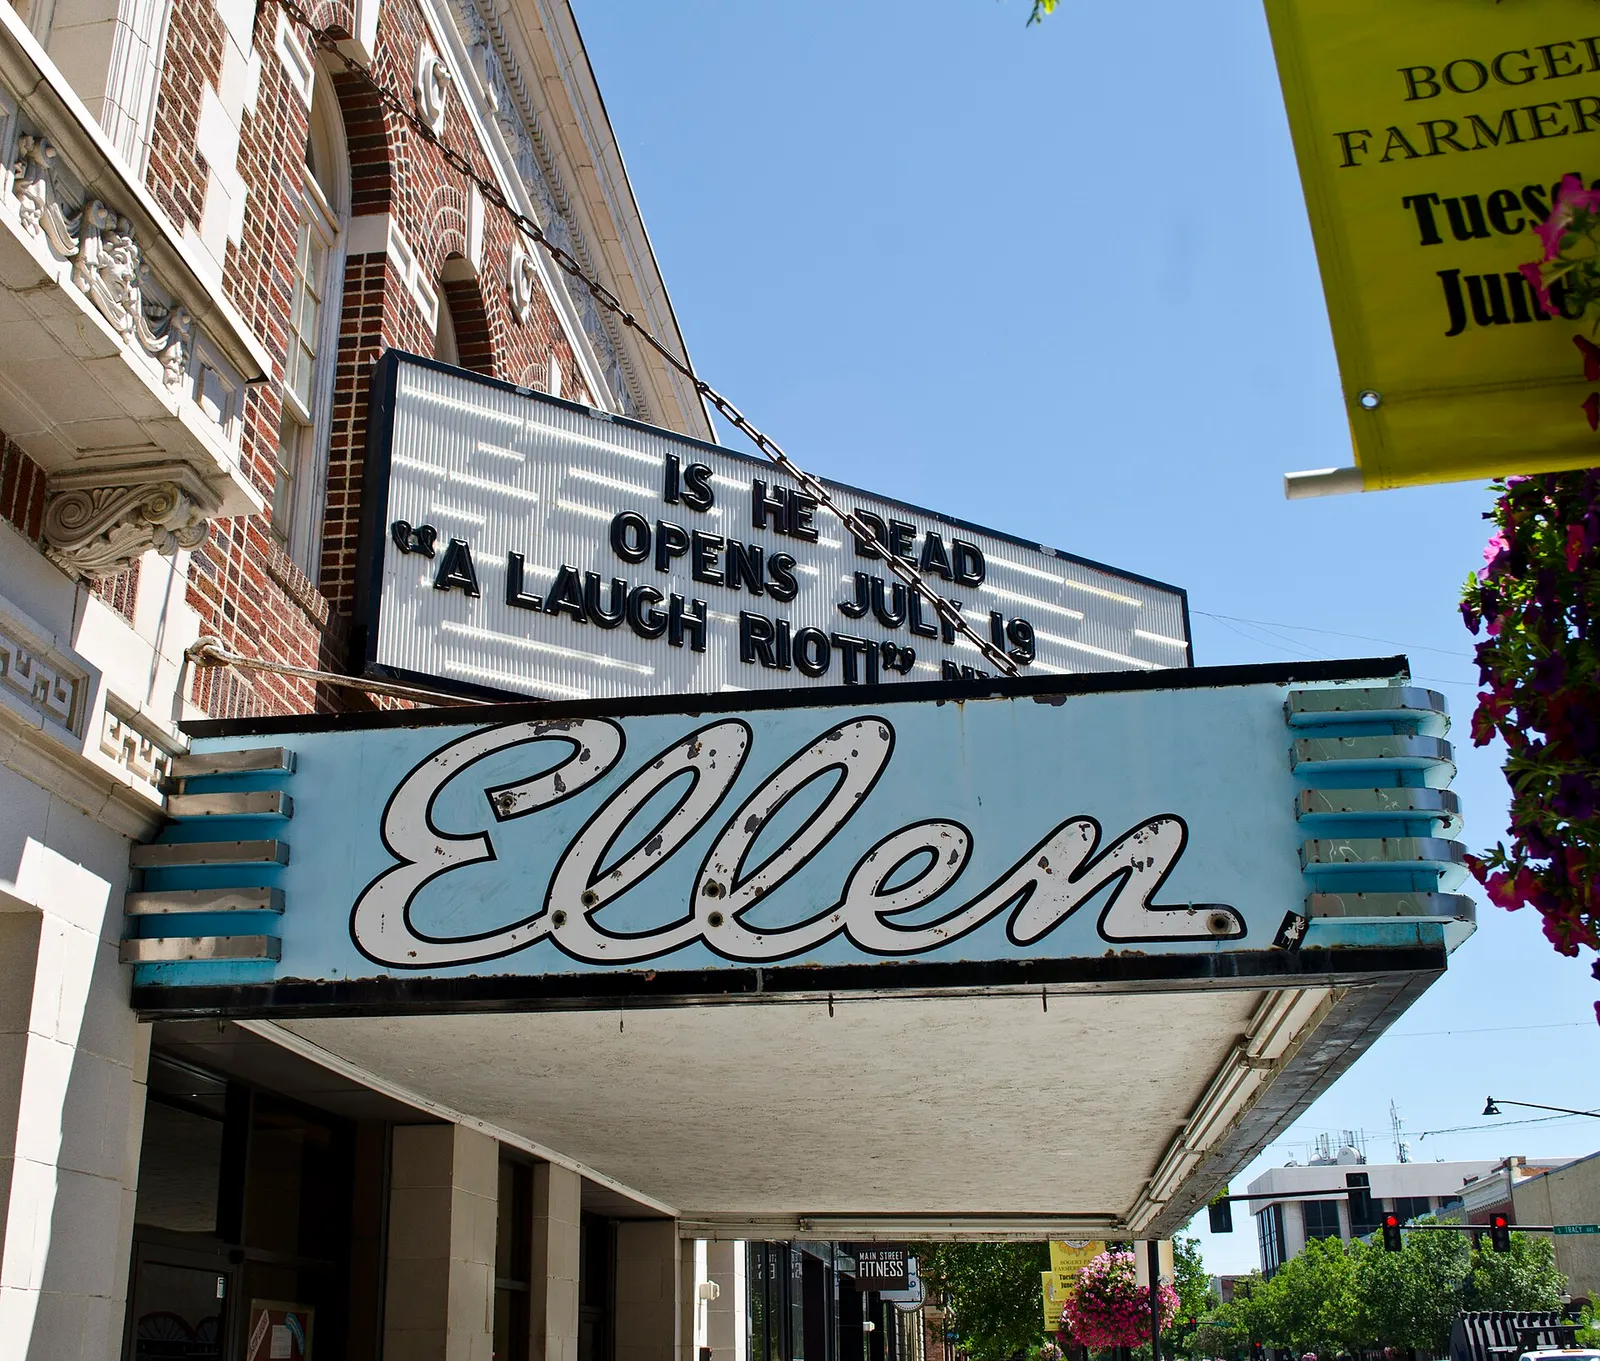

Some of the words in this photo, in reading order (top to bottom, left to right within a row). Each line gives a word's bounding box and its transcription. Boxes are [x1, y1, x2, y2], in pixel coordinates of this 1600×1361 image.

[664, 453, 714, 512] IS
[753, 478, 819, 543] HE
[854, 507, 986, 588] DEAD
[505, 550, 707, 652] LAUGH
[610, 510, 799, 603] OPENS
[838, 571, 963, 645] JULY
[990, 610, 1036, 665] 19
[349, 715, 1247, 969] Ellen
[859, 1251, 877, 1260] MAIN
[880, 1251, 904, 1260] STREET
[859, 1261, 904, 1277] FITNESS
